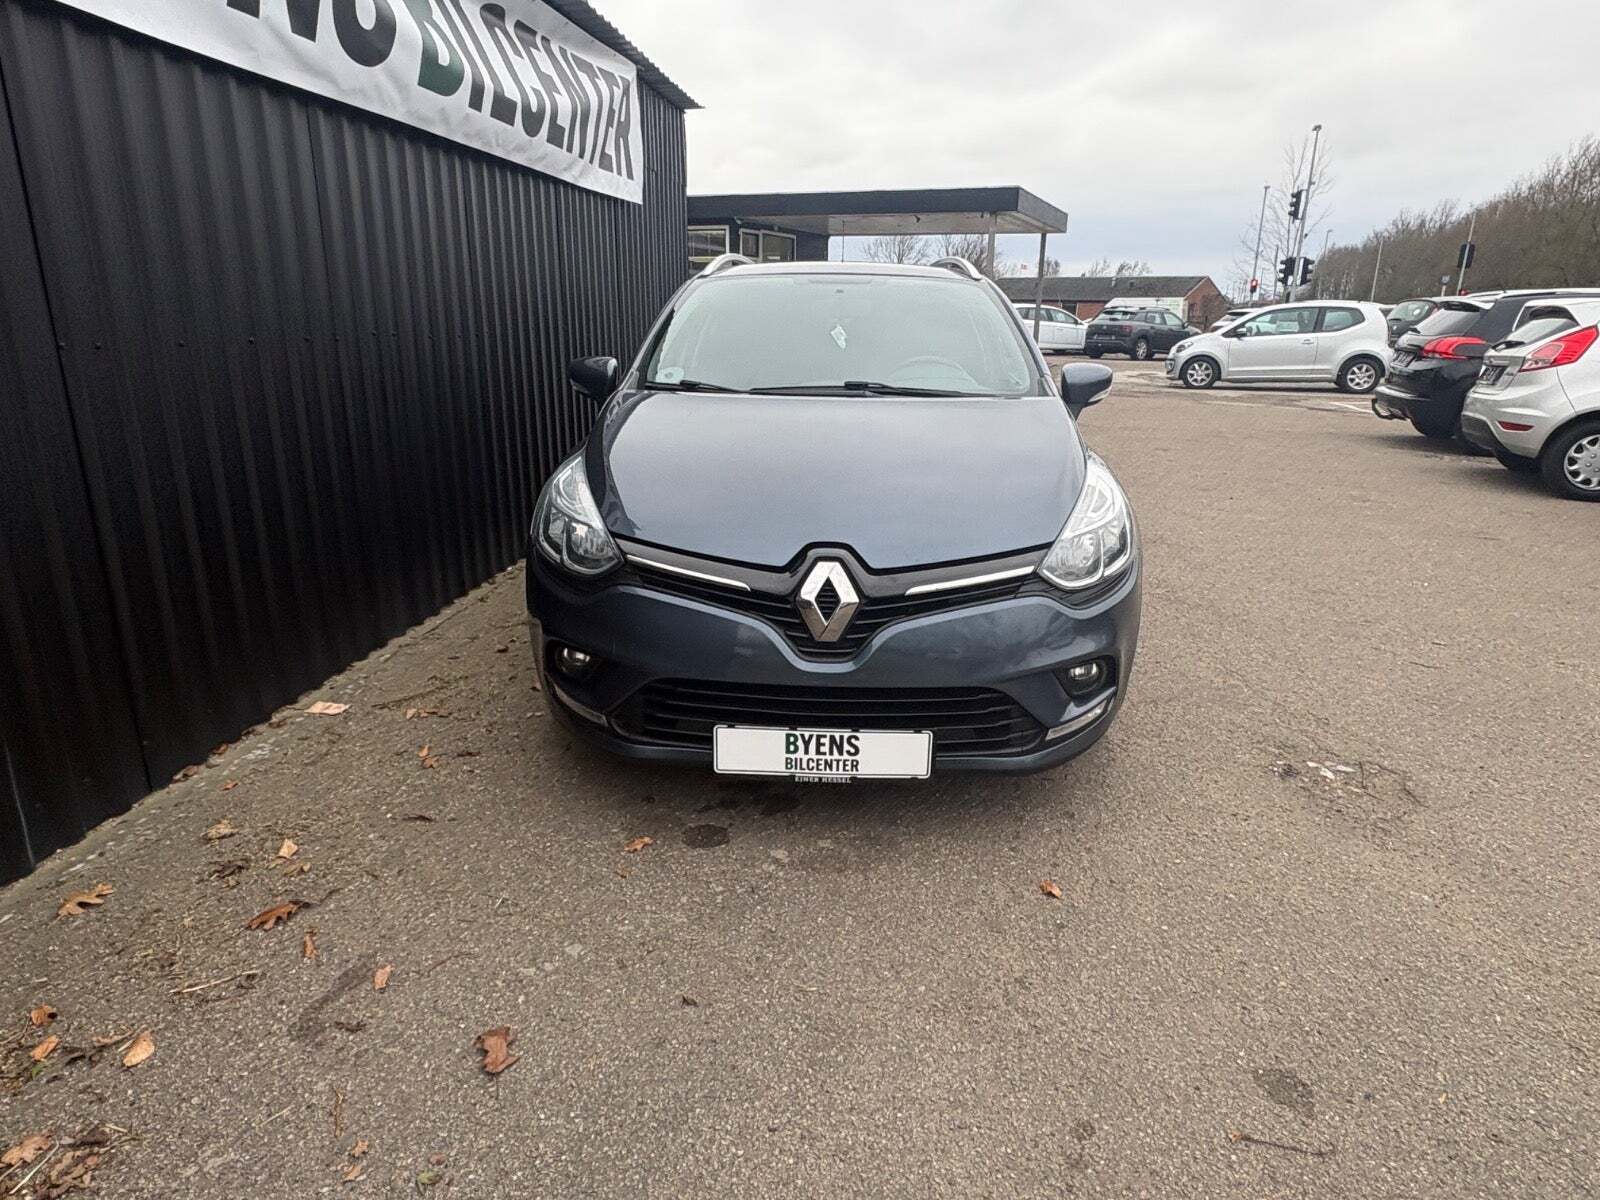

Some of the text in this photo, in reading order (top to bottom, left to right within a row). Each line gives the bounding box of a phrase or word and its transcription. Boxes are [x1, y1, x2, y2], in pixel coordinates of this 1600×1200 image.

[403, 0, 634, 180] BILCENTER
[785, 733, 860, 756] BYENS
[785, 757, 859, 772] BILCENTER
